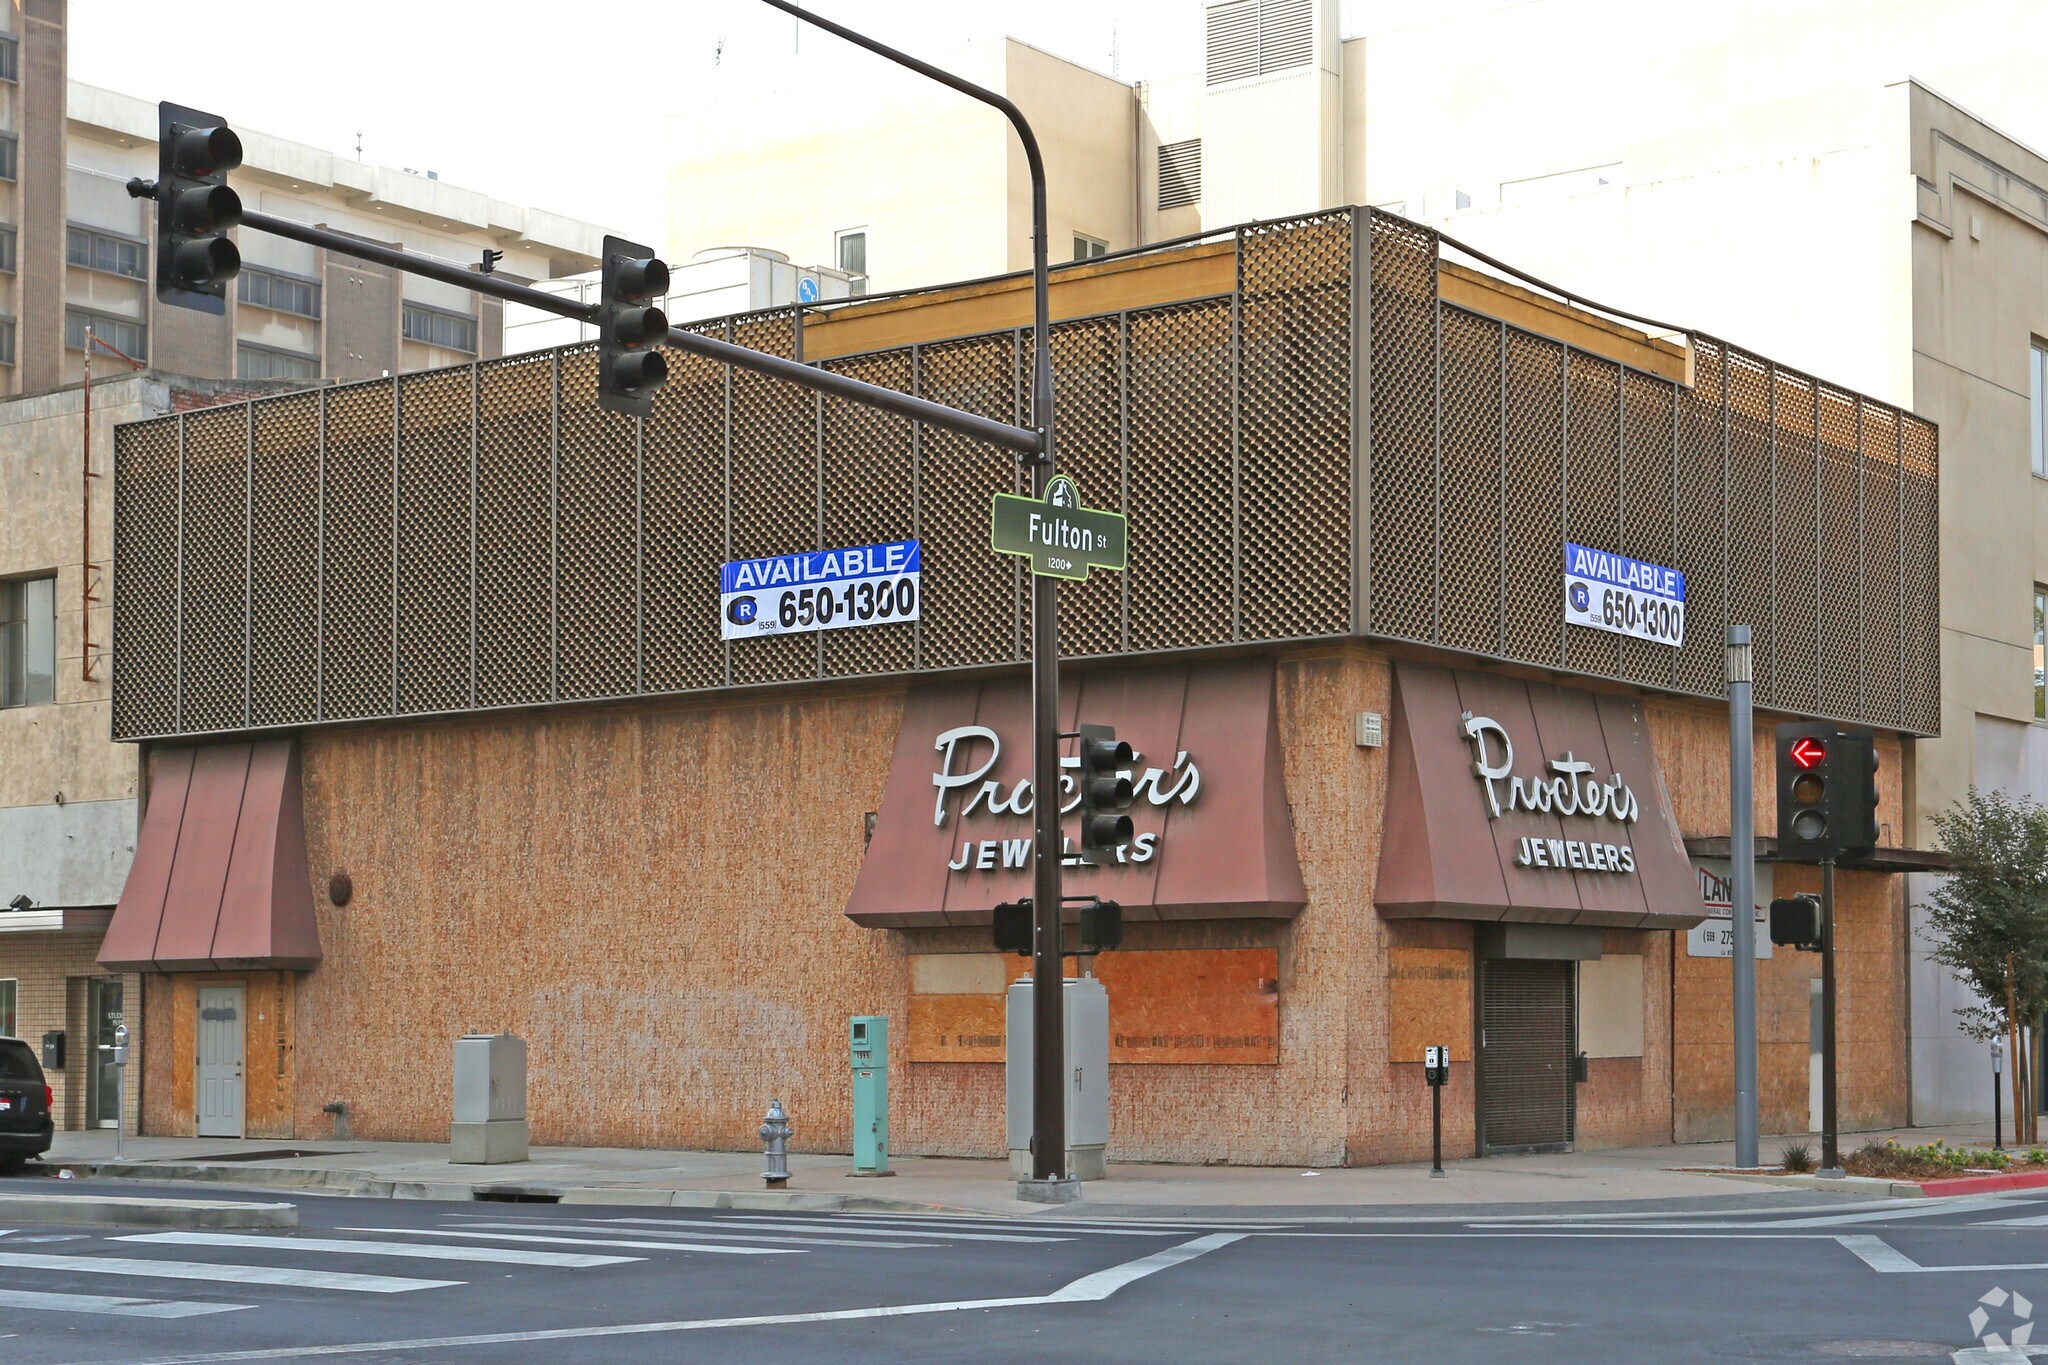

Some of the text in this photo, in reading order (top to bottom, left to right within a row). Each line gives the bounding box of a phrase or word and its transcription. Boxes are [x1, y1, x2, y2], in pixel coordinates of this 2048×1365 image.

[1029, 513, 1107, 552] Fulton St
[735, 545, 906, 589] AVAILABLE
[1048, 557, 1065, 570] 1200
[1573, 549, 1677, 597] AVAILABLE
[758, 578, 915, 631] (559) 650-1300
[1603, 588, 1680, 641] 650-1300
[932, 725, 1201, 827] Procr's
[1461, 714, 1639, 823] Procter's
[948, 832, 1159, 871] JEWLS
[1514, 837, 1635, 873] JEWELERS
[1703, 876, 1732, 902] LAN
